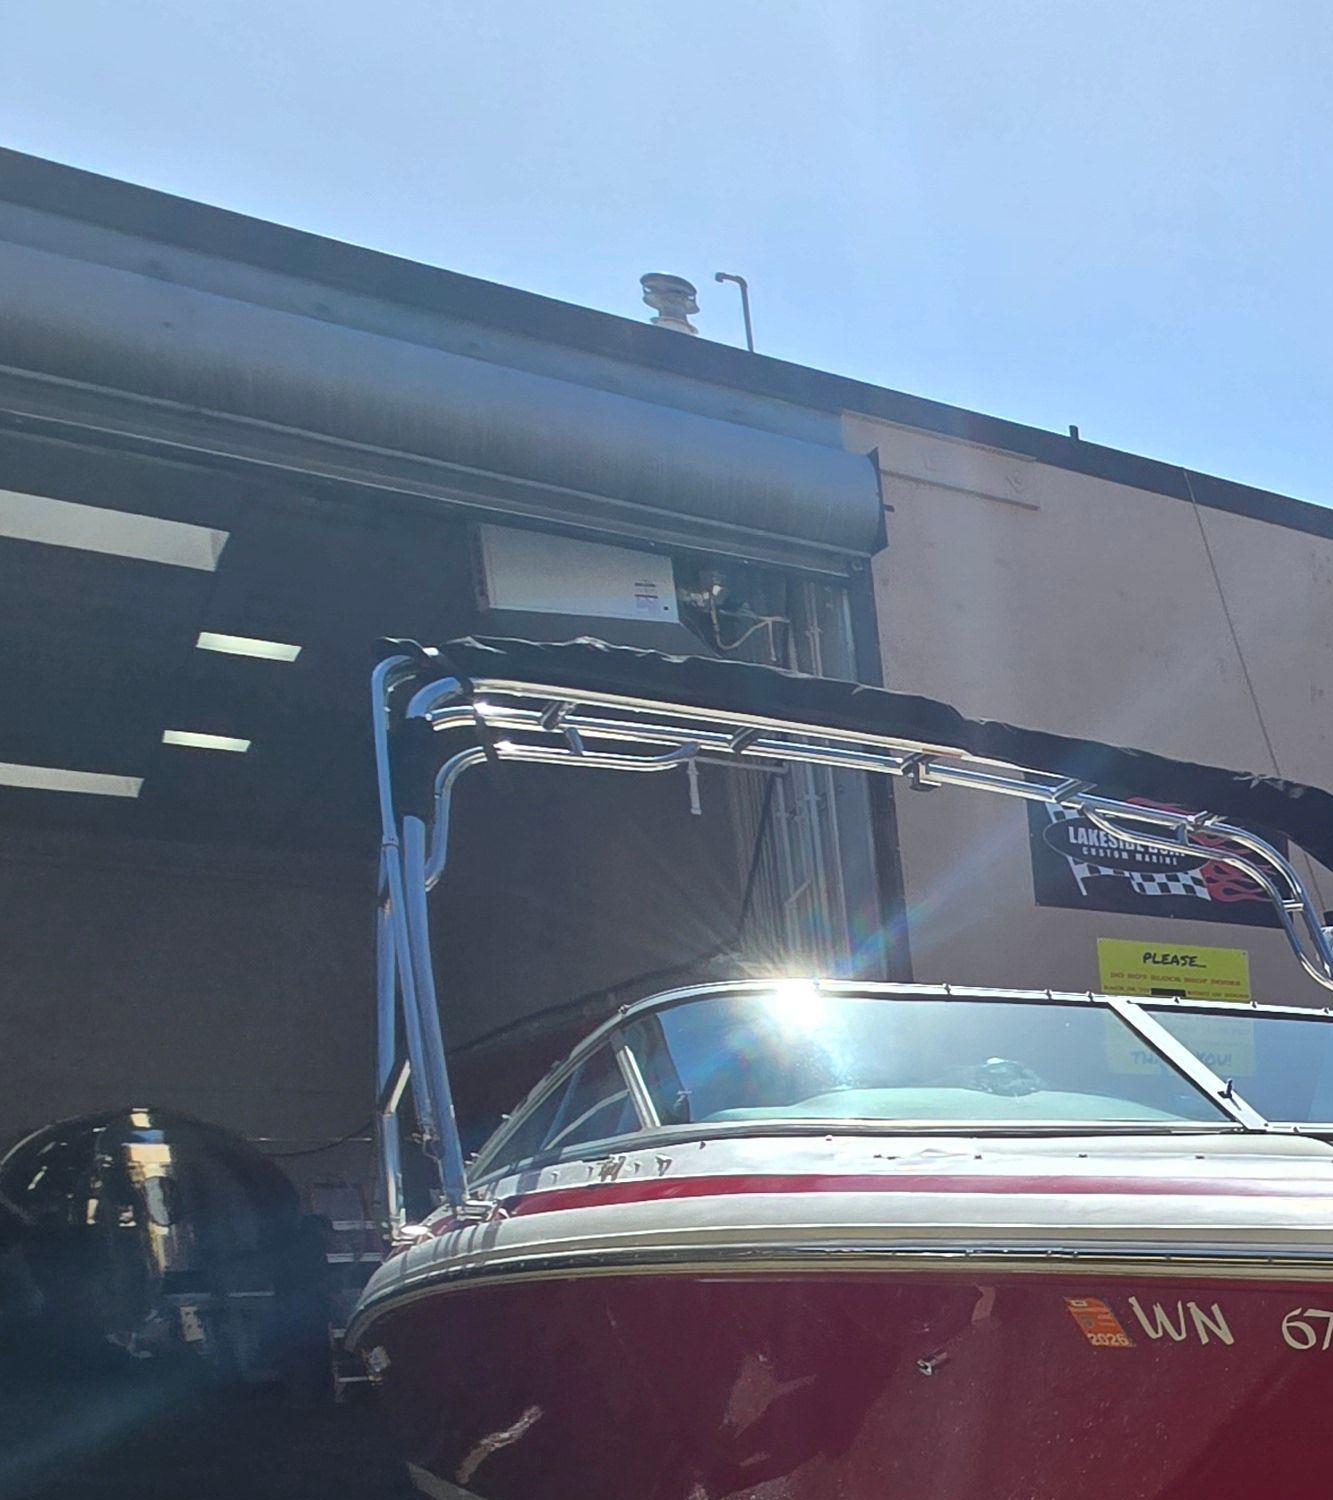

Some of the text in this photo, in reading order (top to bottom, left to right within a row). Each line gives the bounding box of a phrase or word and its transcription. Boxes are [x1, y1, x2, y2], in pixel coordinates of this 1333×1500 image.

[1082, 847, 1177, 865] CUSTOM MARINE
[1128, 1296, 1235, 1345] WN
[1087, 1333, 1130, 1346] 2026
